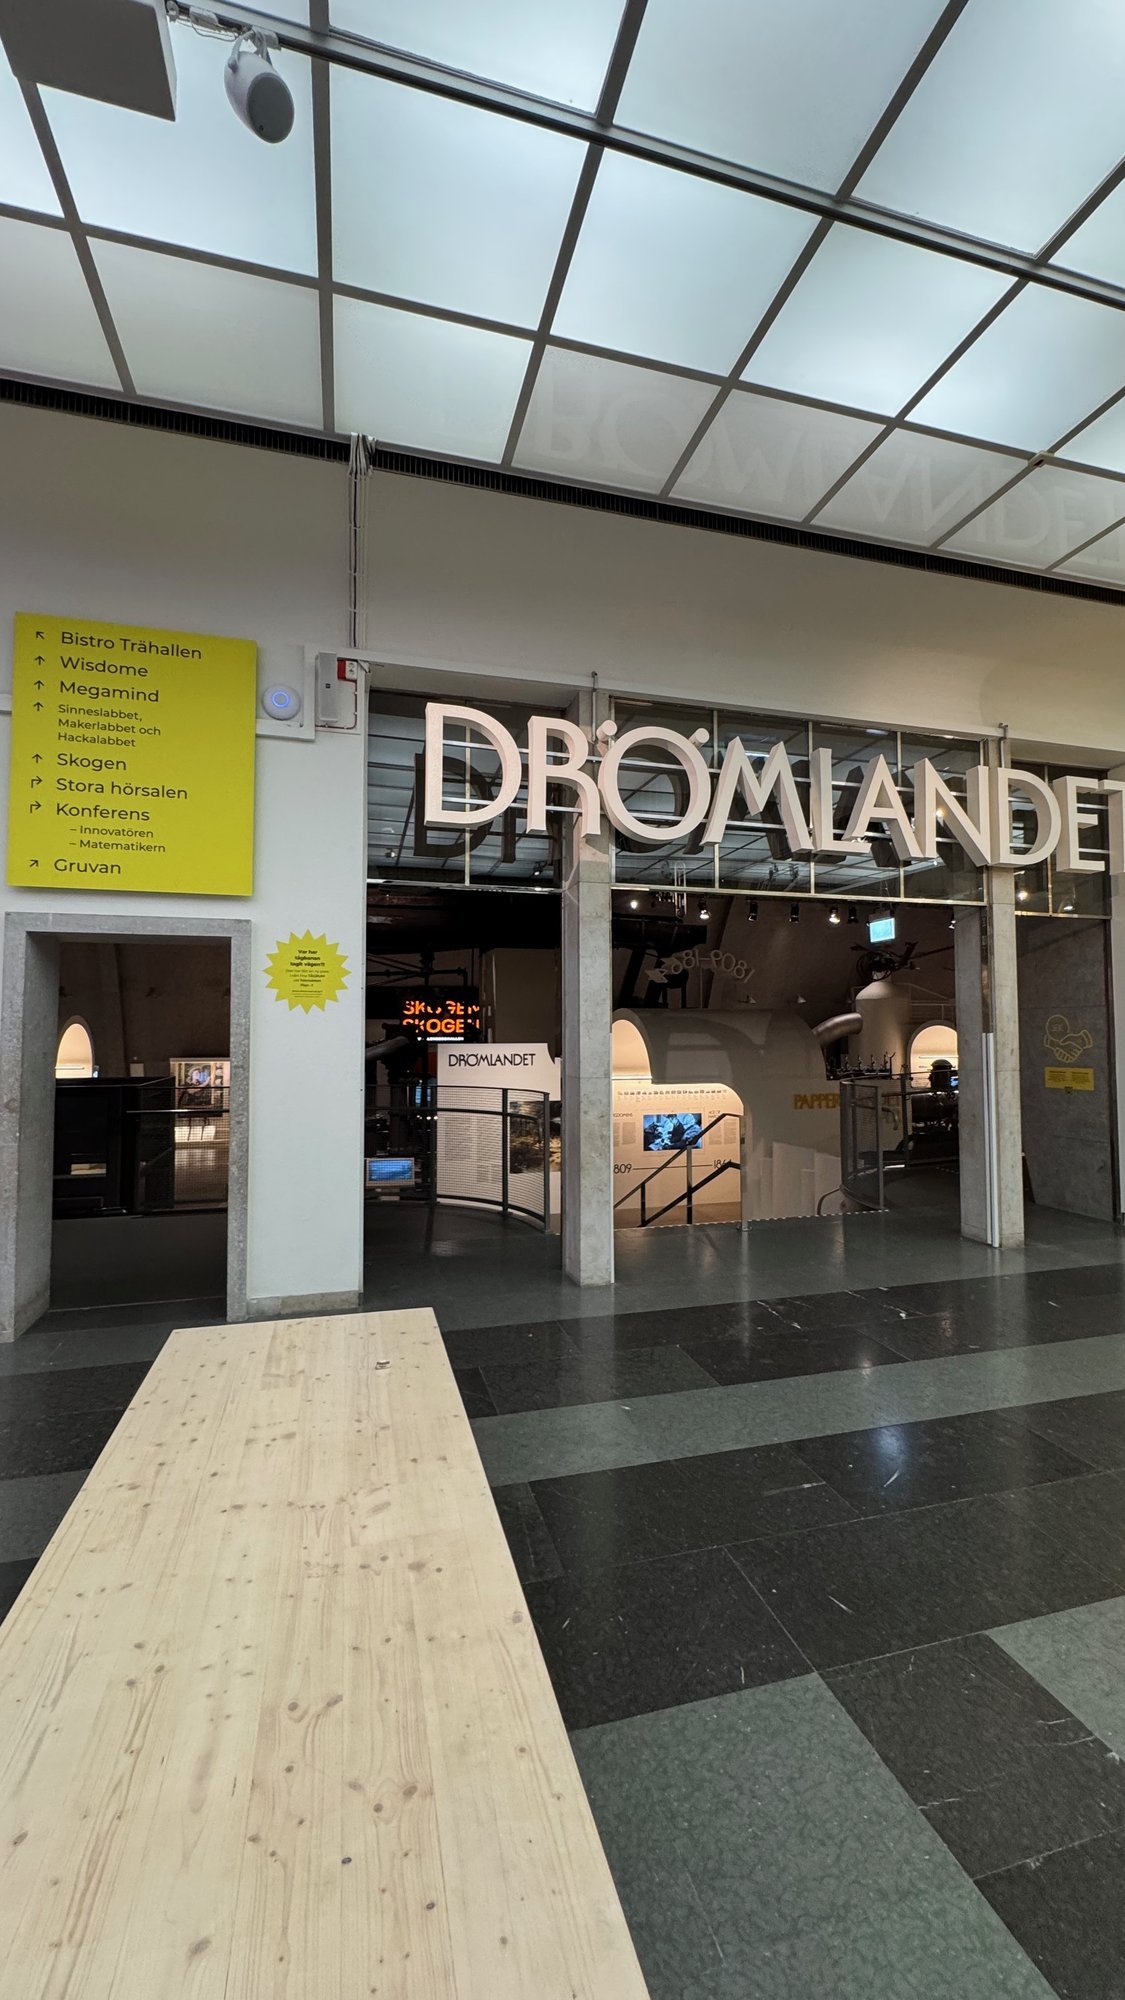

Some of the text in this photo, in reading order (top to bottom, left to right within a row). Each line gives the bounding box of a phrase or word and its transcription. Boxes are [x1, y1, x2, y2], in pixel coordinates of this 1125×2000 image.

[61, 631, 202, 659] Bistro Trähallen
[60, 655, 148, 677] Wisdome
[60, 680, 159, 702] Megamind
[58, 704, 143, 721] Sinneslabbet,
[58, 718, 161, 736] Makerlabbet och
[57, 732, 136, 747] Hackalabbet
[57, 753, 127, 771] Skogen
[56, 778, 188, 799] Stora hörsalen
[56, 803, 150, 821] Konferens
[80, 825, 154, 838] Innovatören
[79, 839, 166, 852] Matematikern
[54, 858, 121, 874] Gruvan
[448, 1053, 536, 1067] DRÖMLANDET
[613, 1163, 632, 1174] 809
